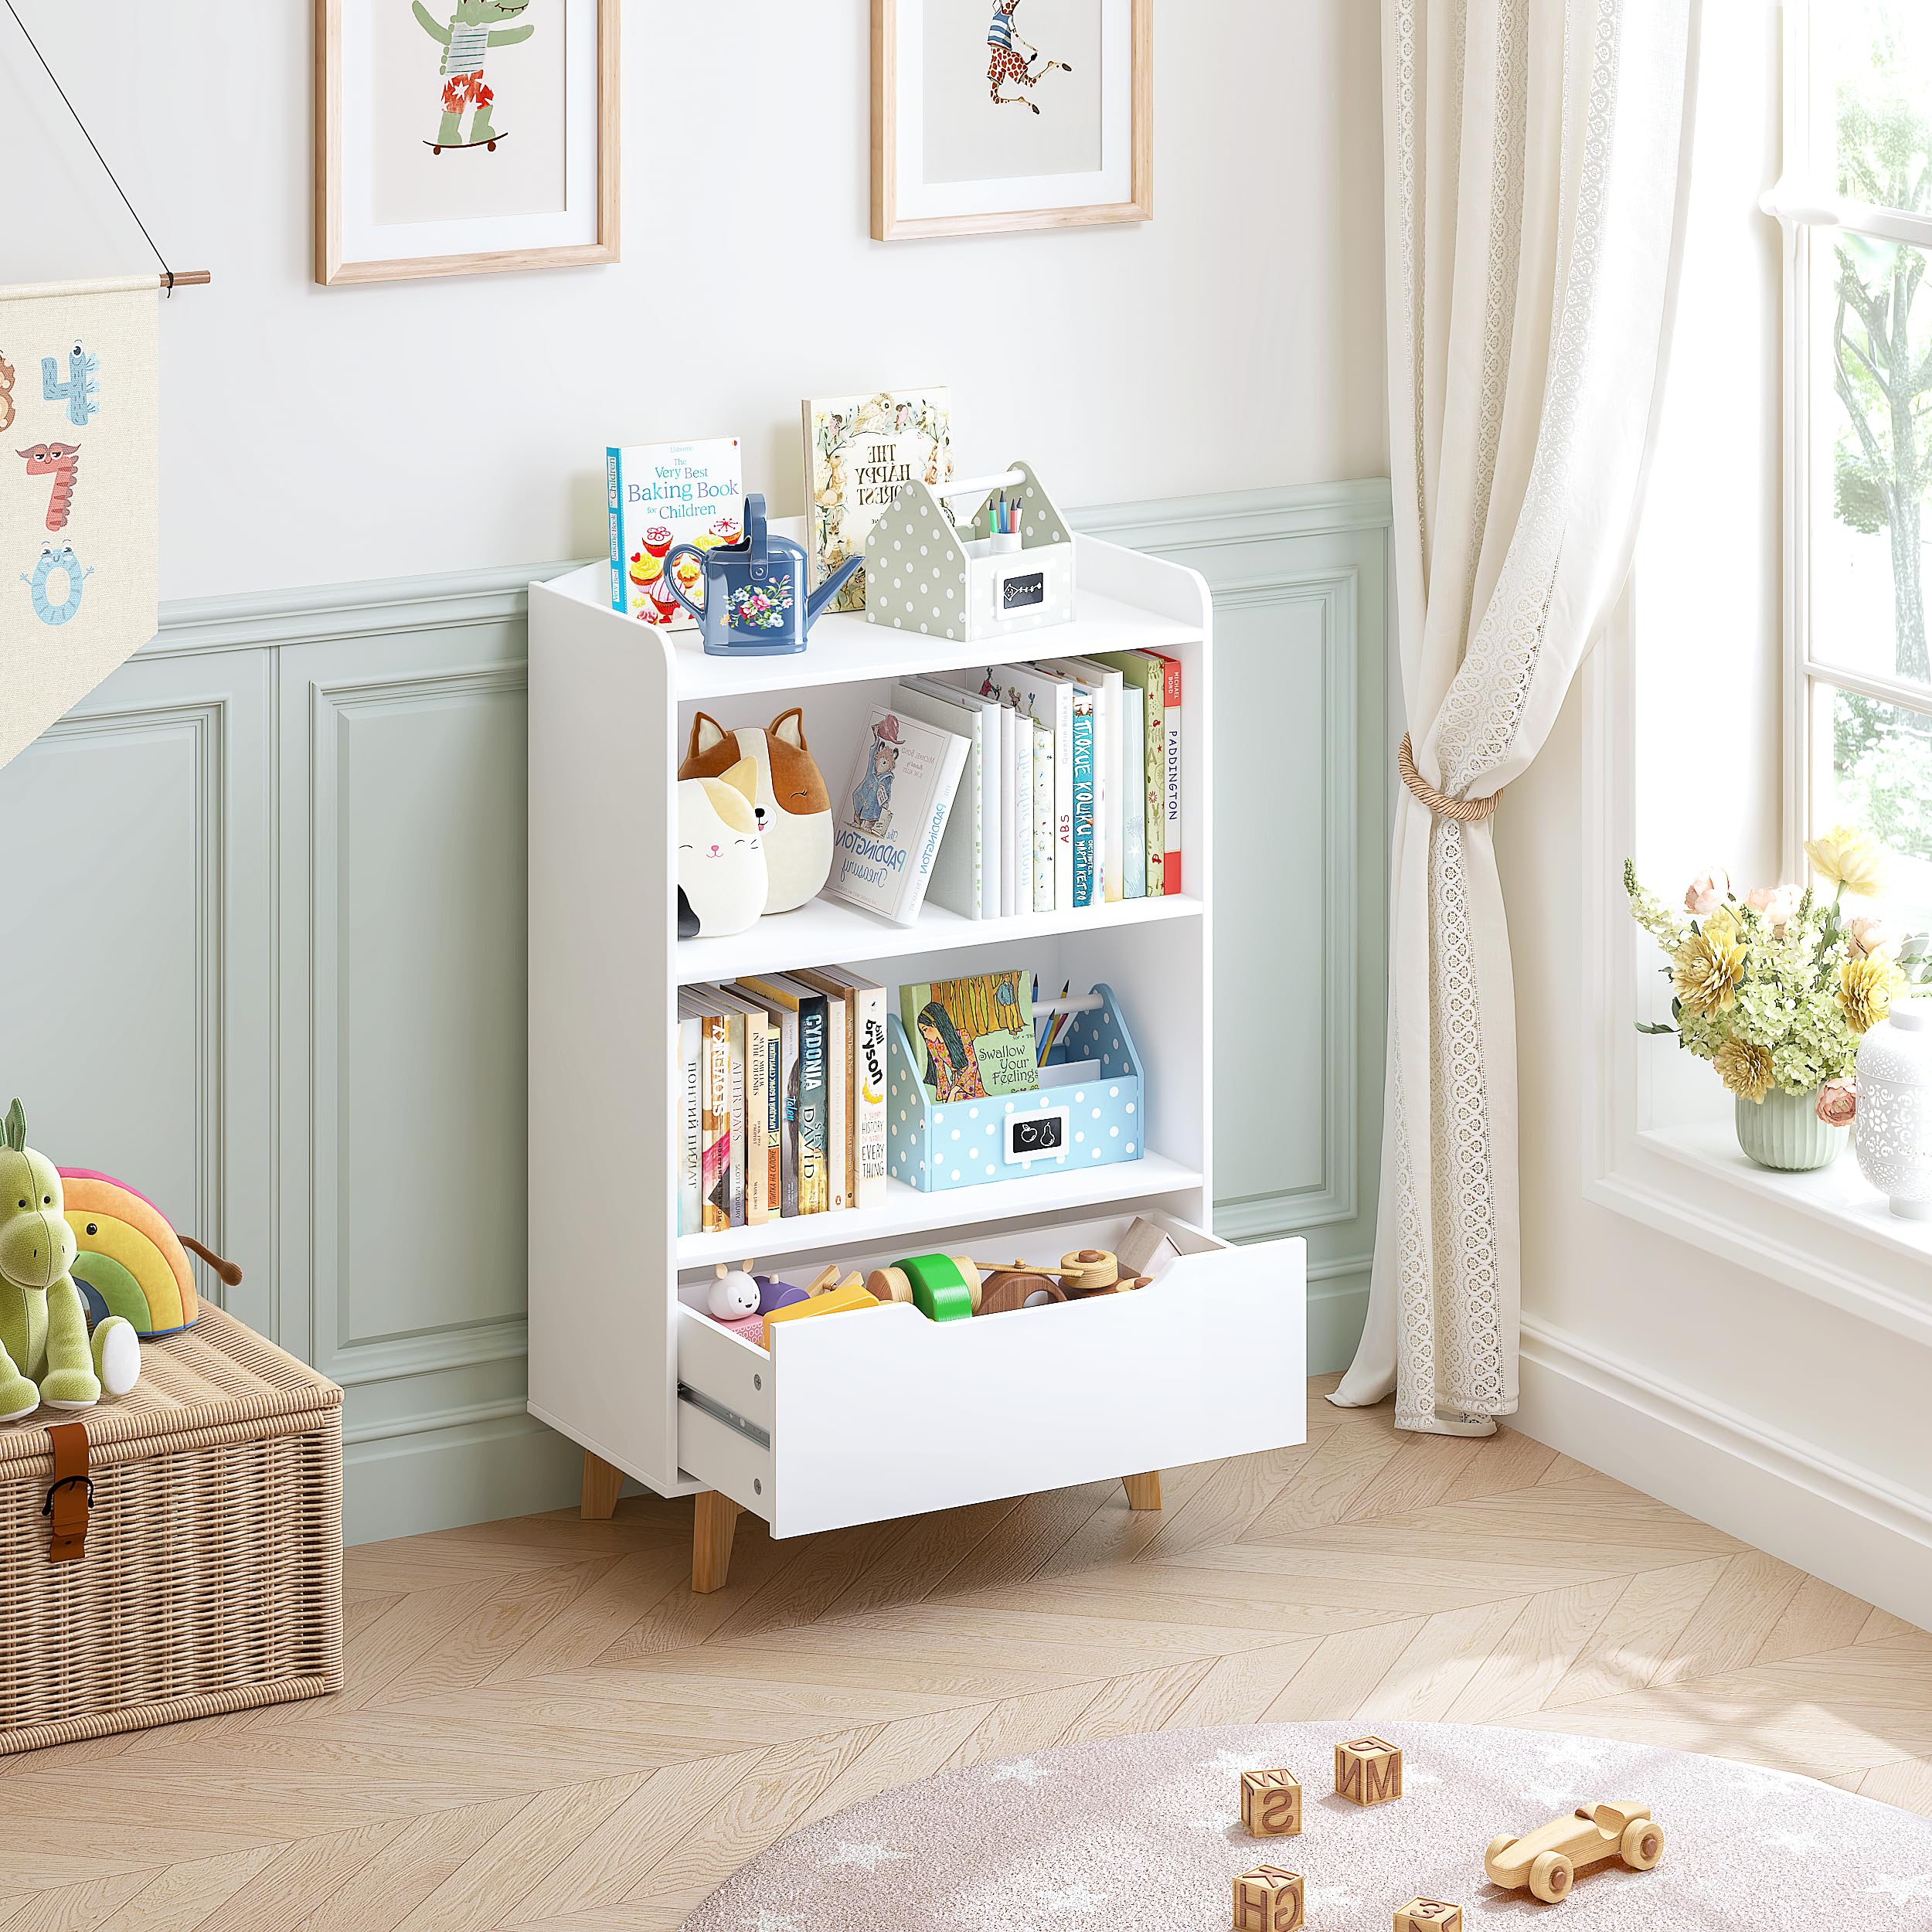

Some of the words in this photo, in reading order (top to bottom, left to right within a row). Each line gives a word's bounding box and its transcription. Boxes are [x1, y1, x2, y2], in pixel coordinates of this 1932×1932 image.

[42, 340, 100, 425] 4
[670, 445, 693, 454] Usborne
[655, 467, 681, 479] Very
[685, 468, 708, 479] Best
[23, 444, 80, 532] 7
[628, 481, 692, 502] Baking
[697, 479, 739, 498] Book
[659, 504, 716, 520] Children
[1073, 719, 1092, 778] ПЛОХИЕ
[1168, 731, 1178, 820] PADDINGTON
[1073, 782, 1092, 836] КОШКИ
[753, 1032, 759, 1041] IN
[876, 1025, 884, 1045] bill
[768, 1043, 777, 1077] СТРУГАЦКИЕ
[805, 1014, 823, 1091] CYDONIA
[862, 1019, 883, 1085] bryson
[978, 1045, 1026, 1060] Swallow
[992, 1069, 1039, 1085] Feelings
[1000, 1059, 1029, 1073] Your
[687, 1063, 699, 1129] ПОНТИЙ
[733, 1062, 743, 1104] AFTER
[768, 1077, 777, 1096] БОРИС
[768, 1103, 777, 1129] АРКАДИЙ
[784, 1095, 798, 1121] talon
[733, 1107, 743, 1141] DAYS
[862, 1121, 883, 1134] HISTORY
[803, 1108, 815, 1179] DAVID
[862, 1144, 884, 1161] EVERY
[687, 1135, 698, 1189] ПИЛАТ
[862, 1162, 884, 1179] THING
[769, 1174, 776, 1182] НА
[1366, 1753, 1399, 1801] M
